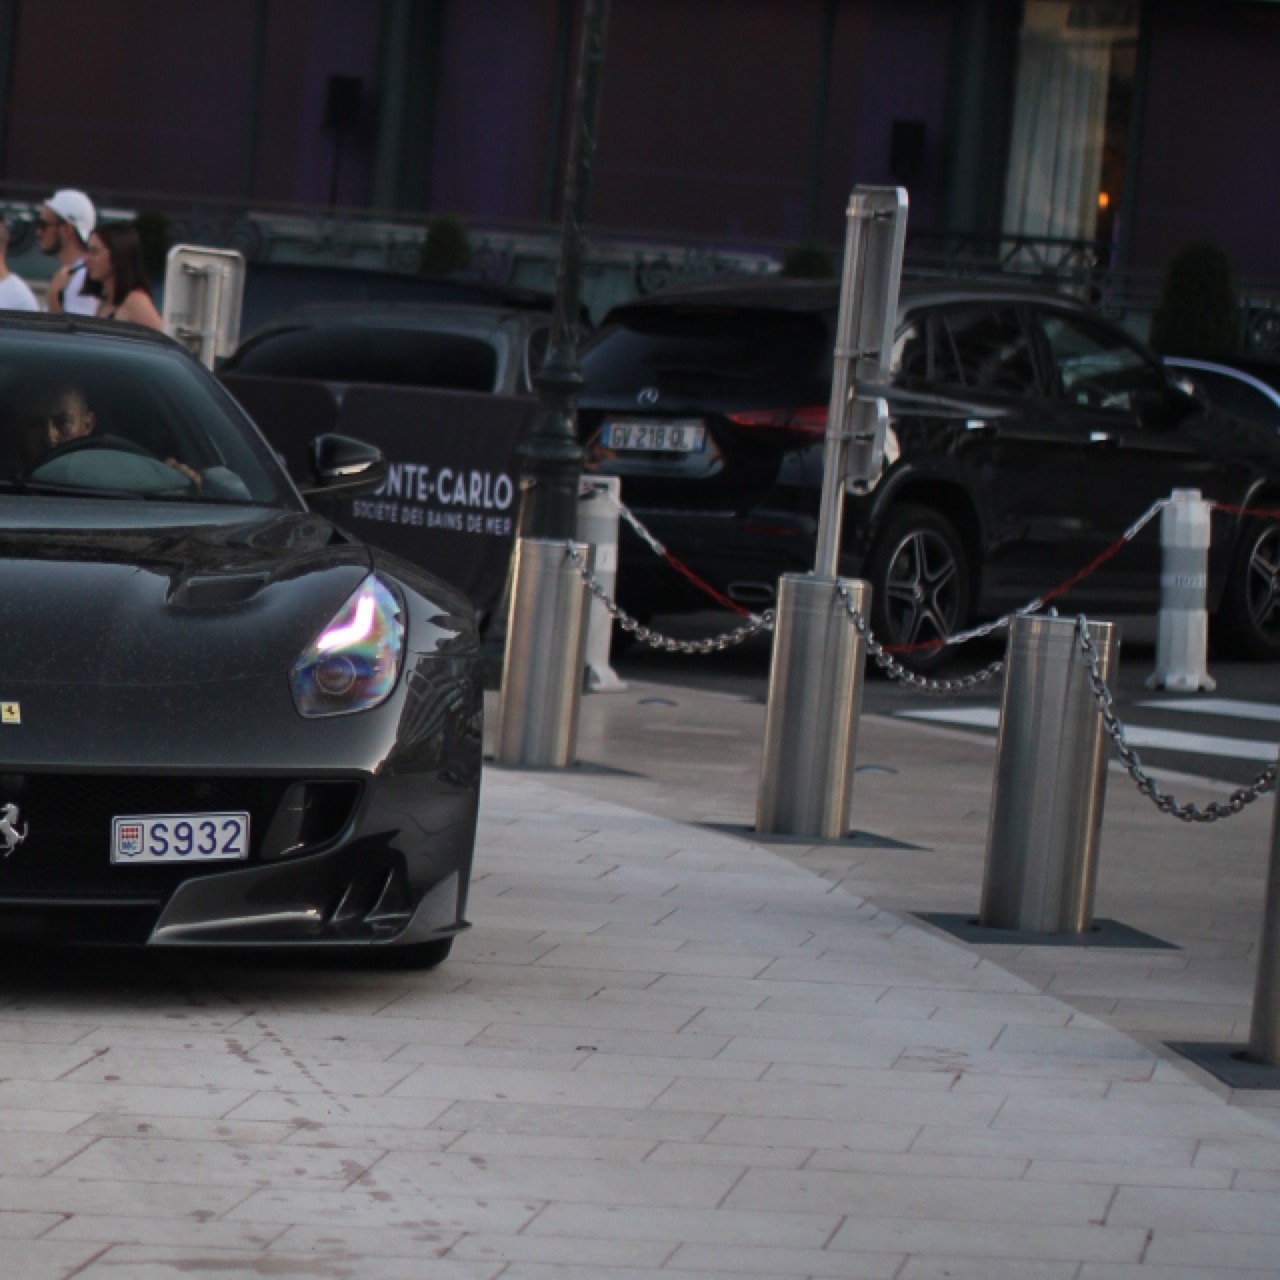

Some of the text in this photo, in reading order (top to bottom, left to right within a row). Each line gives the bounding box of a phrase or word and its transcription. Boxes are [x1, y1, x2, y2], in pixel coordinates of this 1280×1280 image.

[374, 463, 514, 510] NTE-CARLO
[467, 513, 483, 533] DE
[149, 819, 241, 856] S932
